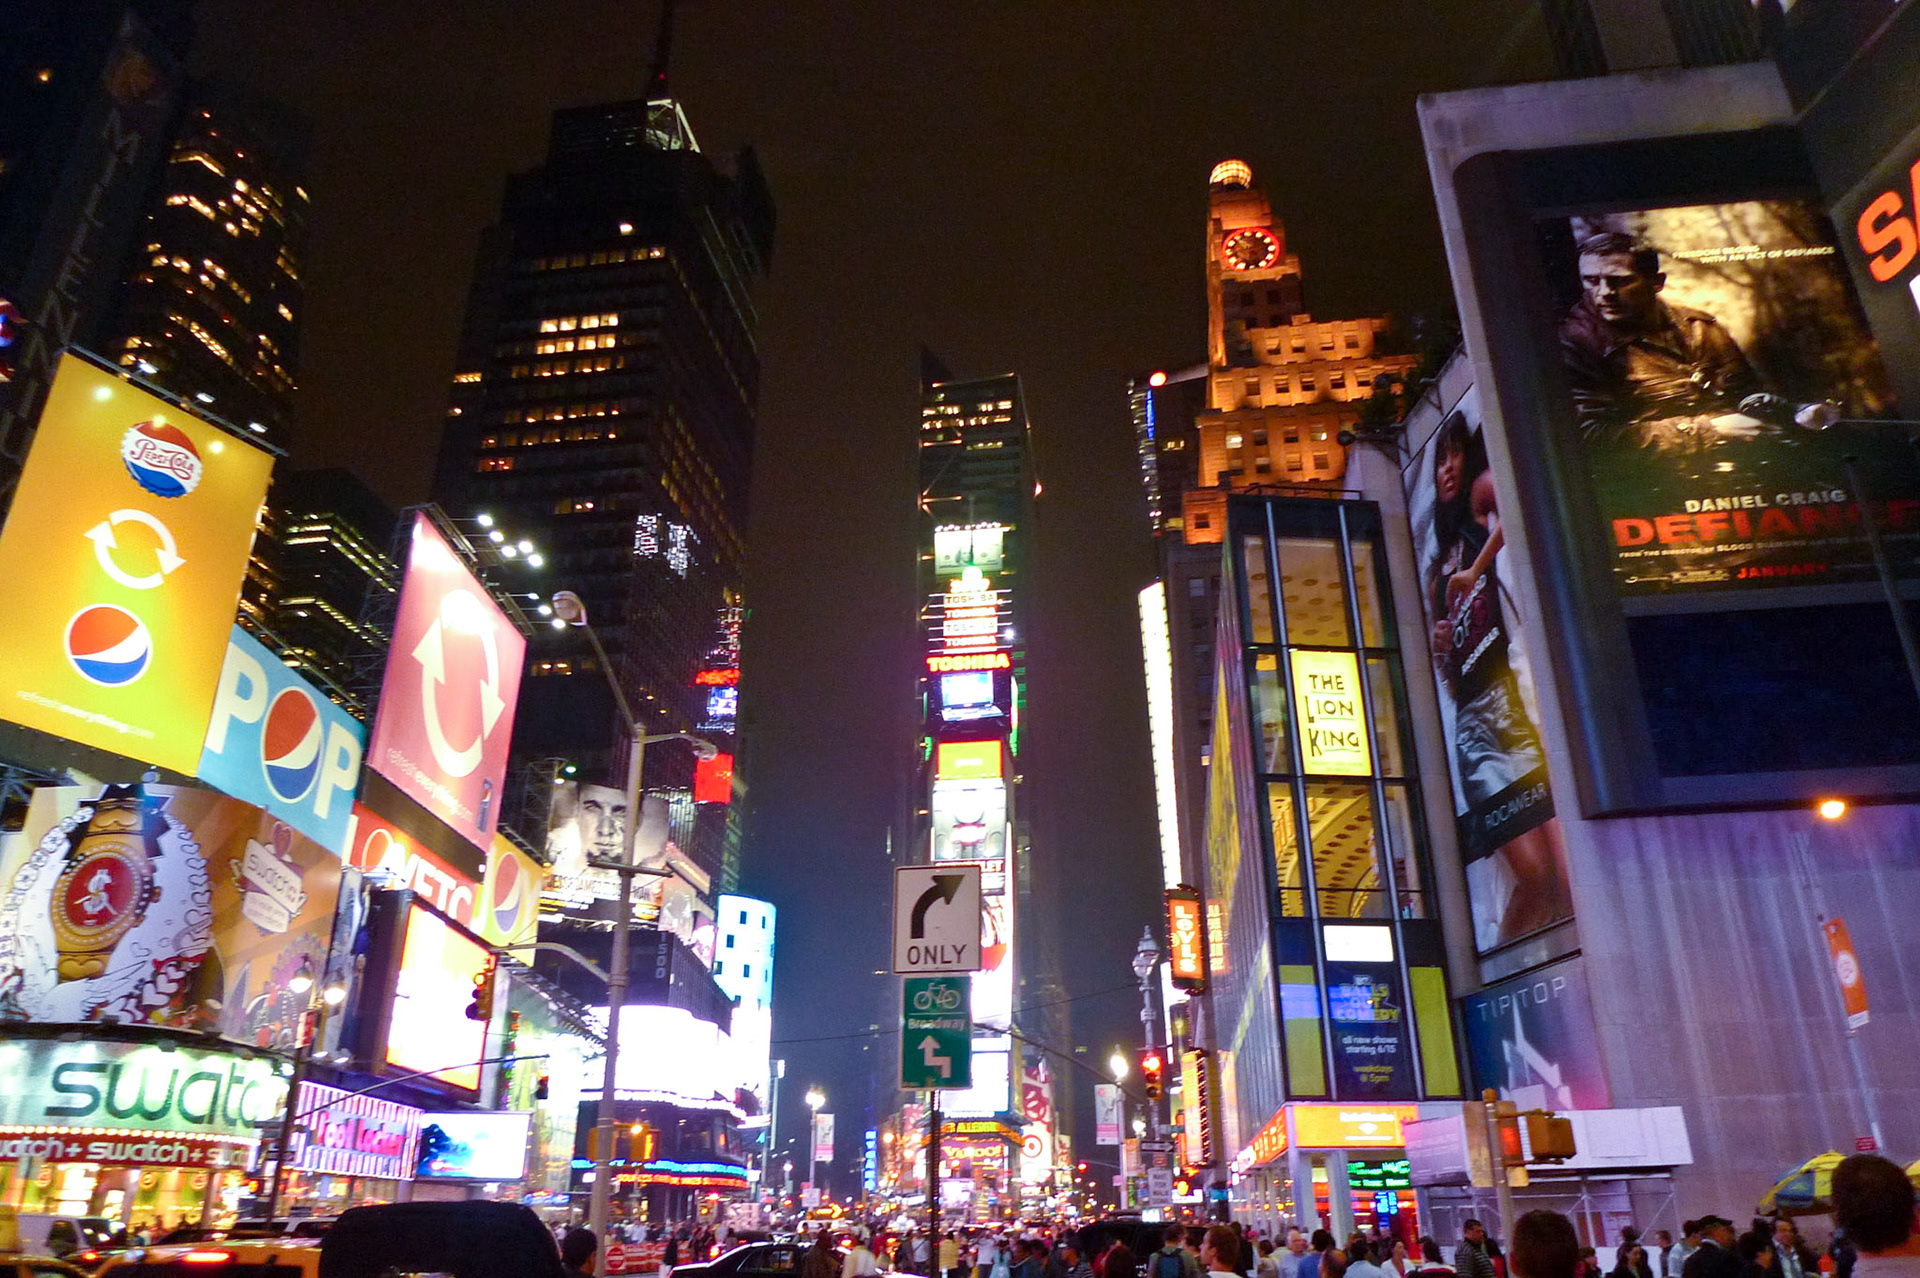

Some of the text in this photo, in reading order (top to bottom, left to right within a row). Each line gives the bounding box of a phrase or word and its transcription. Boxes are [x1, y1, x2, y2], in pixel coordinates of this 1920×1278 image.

[1746, 251, 1767, 261] ACT
[1767, 249, 1783, 258] OF
[1783, 246, 1835, 258] DEFIANCE
[1684, 488, 1847, 513] DANIEL CRAIG
[927, 654, 1010, 672] TOSHIBA
[1309, 675, 1344, 690] THE
[1305, 696, 1353, 723] LION
[1308, 728, 1359, 757] KING
[1484, 782, 1548, 832] ROCAWEAR
[907, 943, 967, 965] ONLY
[908, 1016, 966, 1031] Broadway
[43, 1062, 275, 1130] swatc
[87, 1140, 189, 1164] swatch
